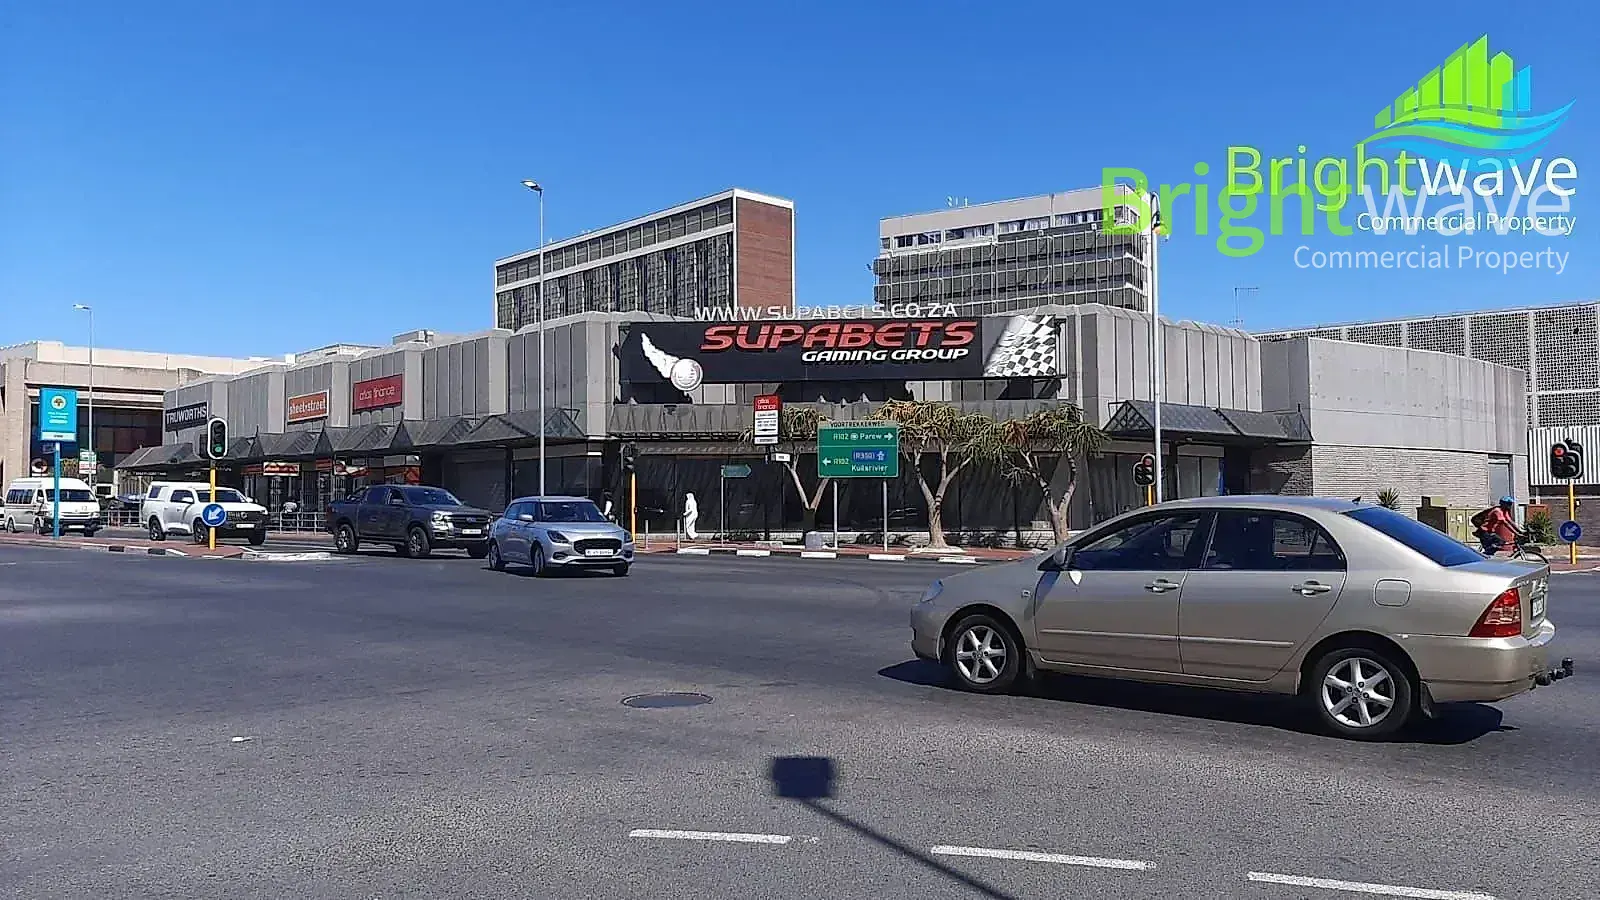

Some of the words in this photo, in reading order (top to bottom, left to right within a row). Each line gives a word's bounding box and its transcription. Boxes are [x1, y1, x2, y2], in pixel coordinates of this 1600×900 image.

[700, 321, 978, 350] SUPABETS
[802, 350, 888, 362] GAMING
[891, 349, 969, 361] GROUP
[166, 405, 208, 425] TRUWORTHS
[859, 432, 882, 440] Parow
